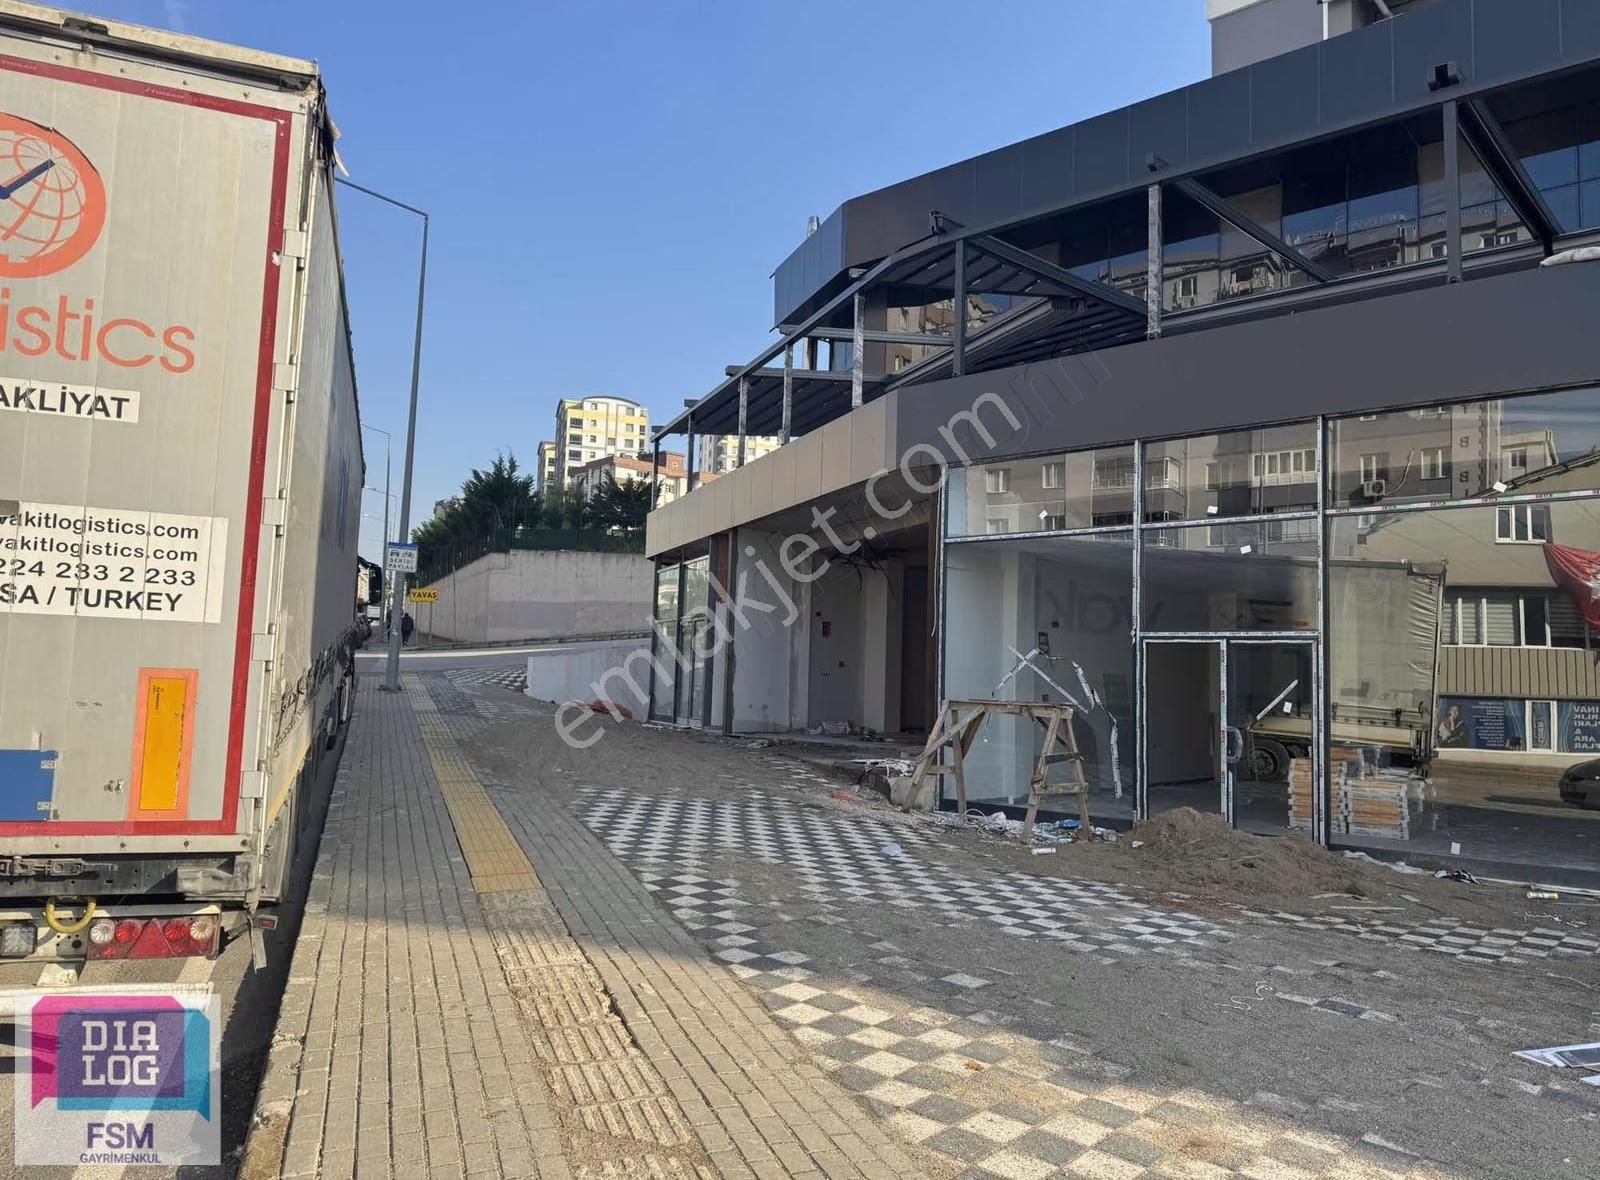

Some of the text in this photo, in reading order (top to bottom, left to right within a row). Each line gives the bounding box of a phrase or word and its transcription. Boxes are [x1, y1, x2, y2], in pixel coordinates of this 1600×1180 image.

[0, 287, 196, 374] istics
[55, 561, 109, 581] 233
[119, 565, 135, 583] 2
[145, 567, 196, 587] 233
[65, 586, 184, 613] TURKEY
